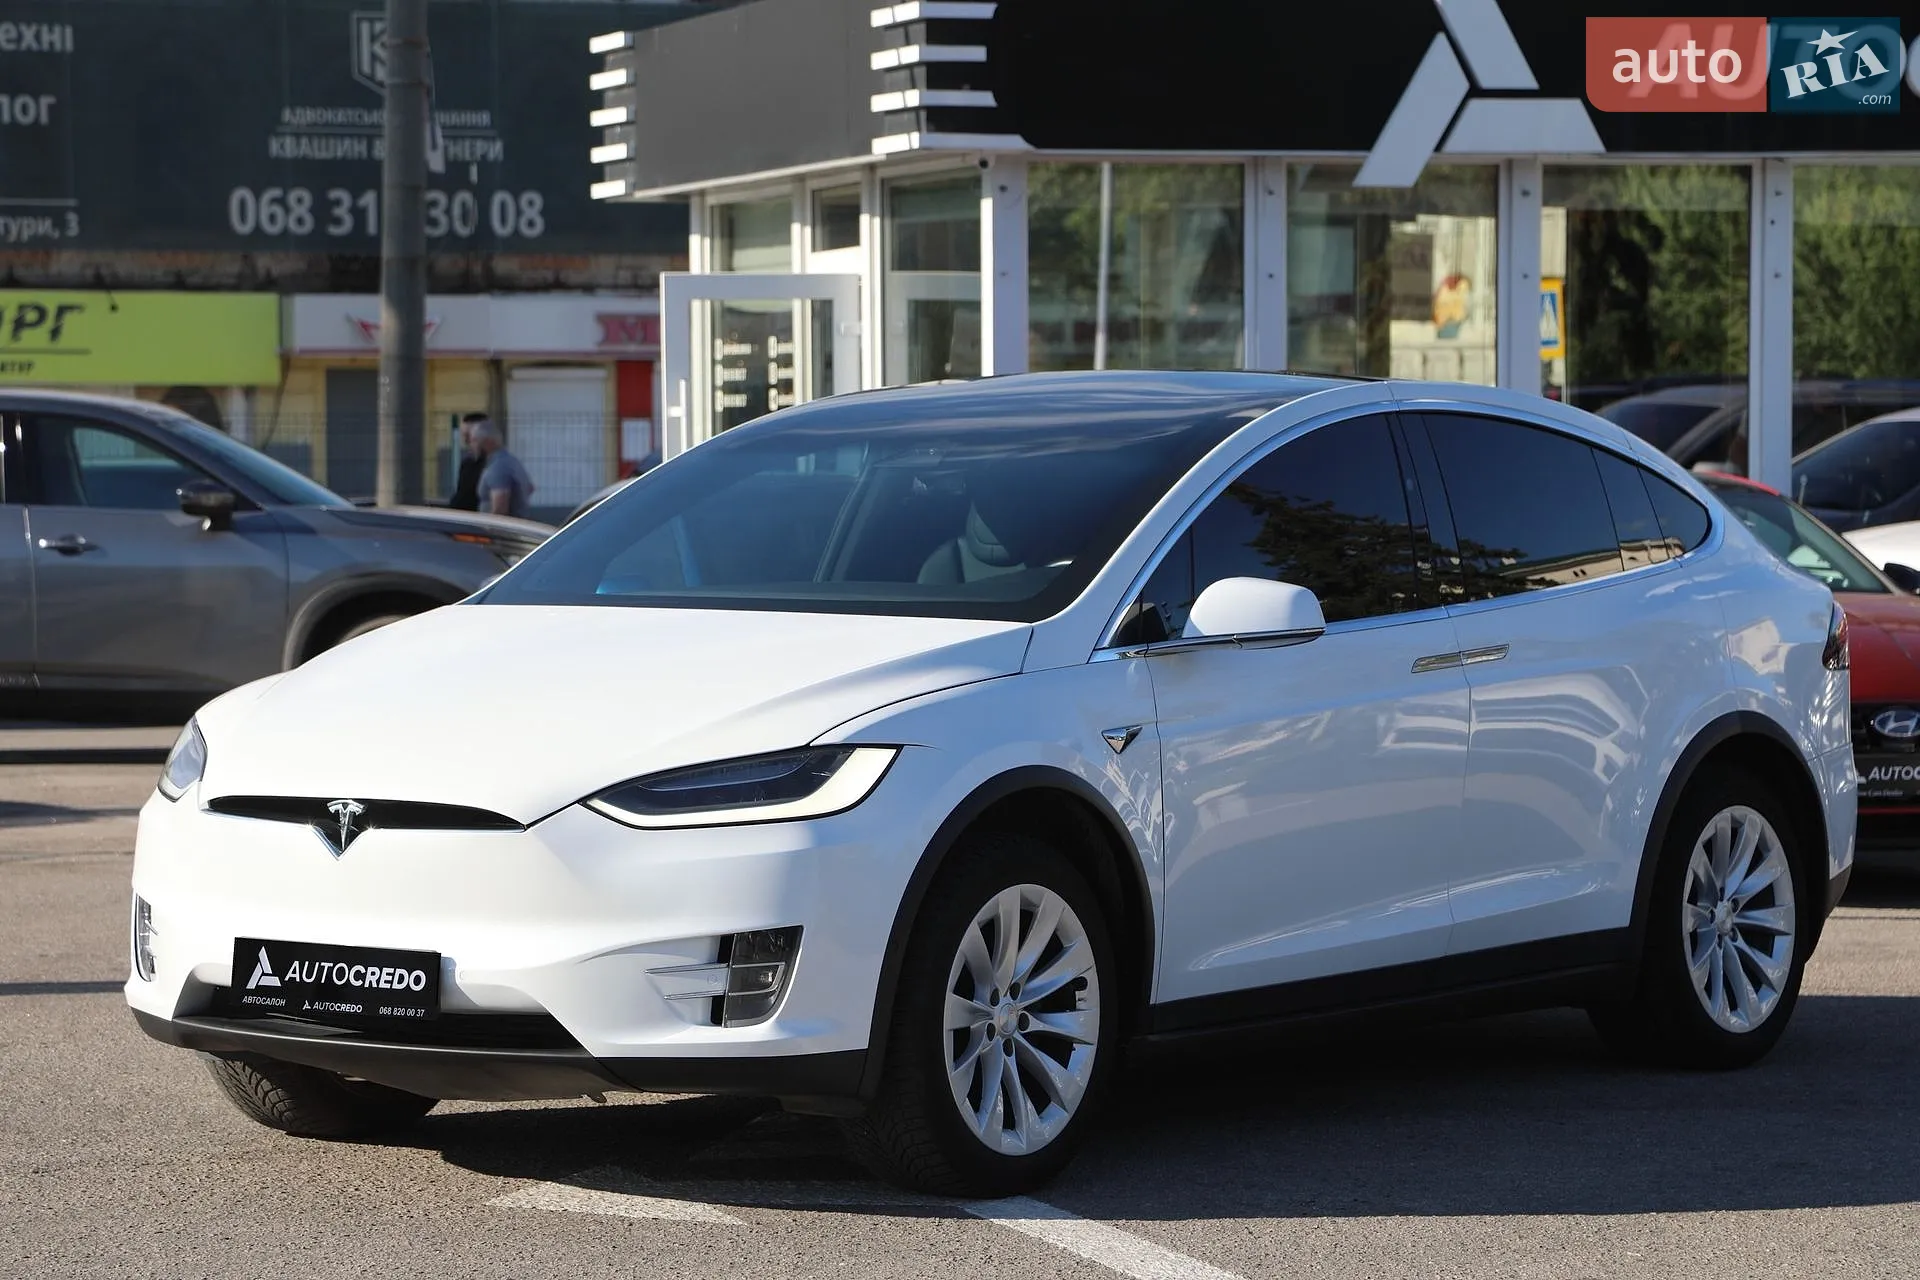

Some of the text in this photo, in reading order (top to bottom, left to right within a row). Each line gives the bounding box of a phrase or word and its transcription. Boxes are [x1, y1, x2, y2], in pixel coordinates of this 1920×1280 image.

[268, 135, 368, 159] КВАШИН
[229, 186, 545, 238] 068 31 30 08
[0, 302, 86, 343] РГ
[284, 960, 427, 992] AUTOCREDO
[242, 995, 286, 1007] АВТОСАЛОН
[312, 1001, 363, 1013] AUTOCREDO
[379, 1006, 425, 1018] 068 820 00 37
